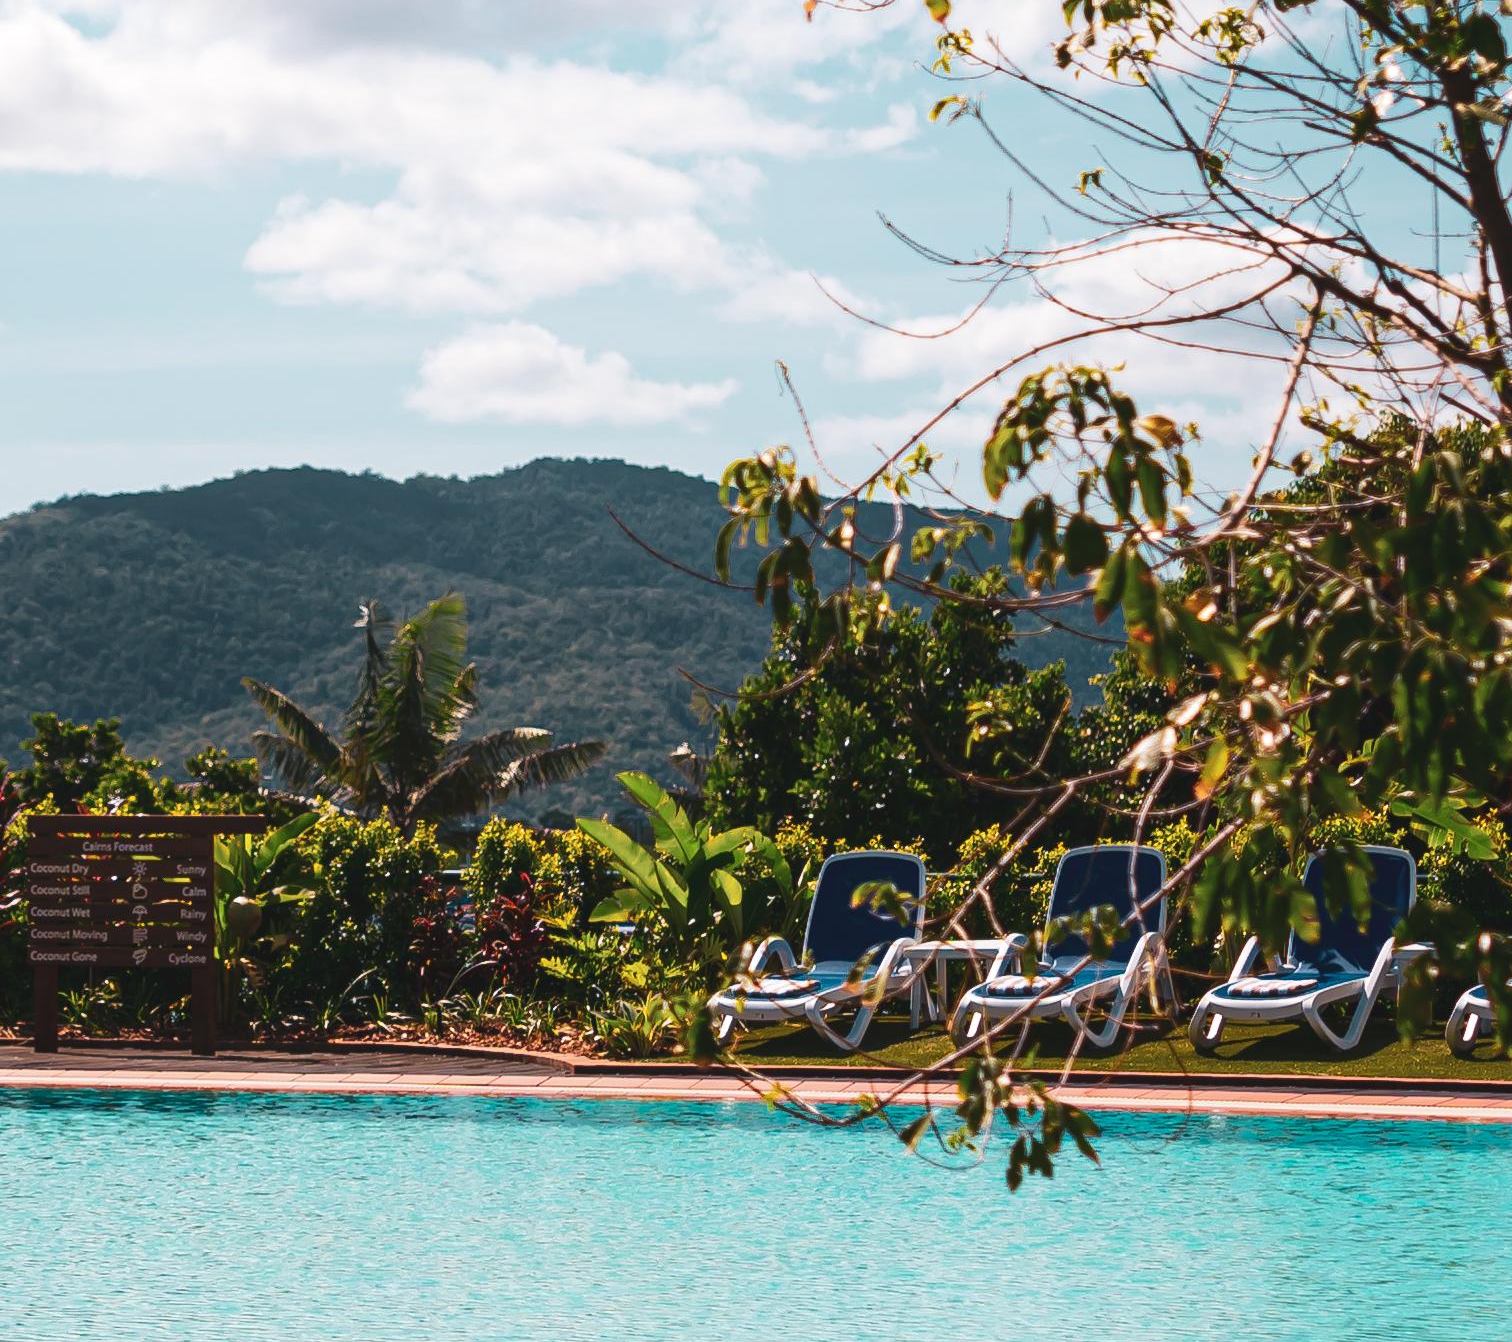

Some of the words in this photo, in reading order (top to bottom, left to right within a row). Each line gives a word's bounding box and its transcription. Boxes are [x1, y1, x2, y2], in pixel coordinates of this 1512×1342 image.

[83, 842, 112, 851] Cairns
[114, 842, 152, 851] Forecast
[30, 863, 70, 873] Coconut
[72, 864, 89, 875] Dry
[177, 865, 207, 876] Sunny
[30, 886, 70, 895] Coconut
[72, 885, 90, 895] Still
[182, 887, 207, 896] Calm
[30, 907, 70, 916] Coconut
[71, 908, 90, 917] Wet
[180, 909, 207, 920] Rainy
[30, 929, 70, 938] Coconut
[72, 930, 108, 942] Moving
[176, 932, 207, 942] Windy
[30, 951, 70, 960] Coconut
[71, 952, 98, 961] Gone
[169, 954, 207, 964] Cyclone
